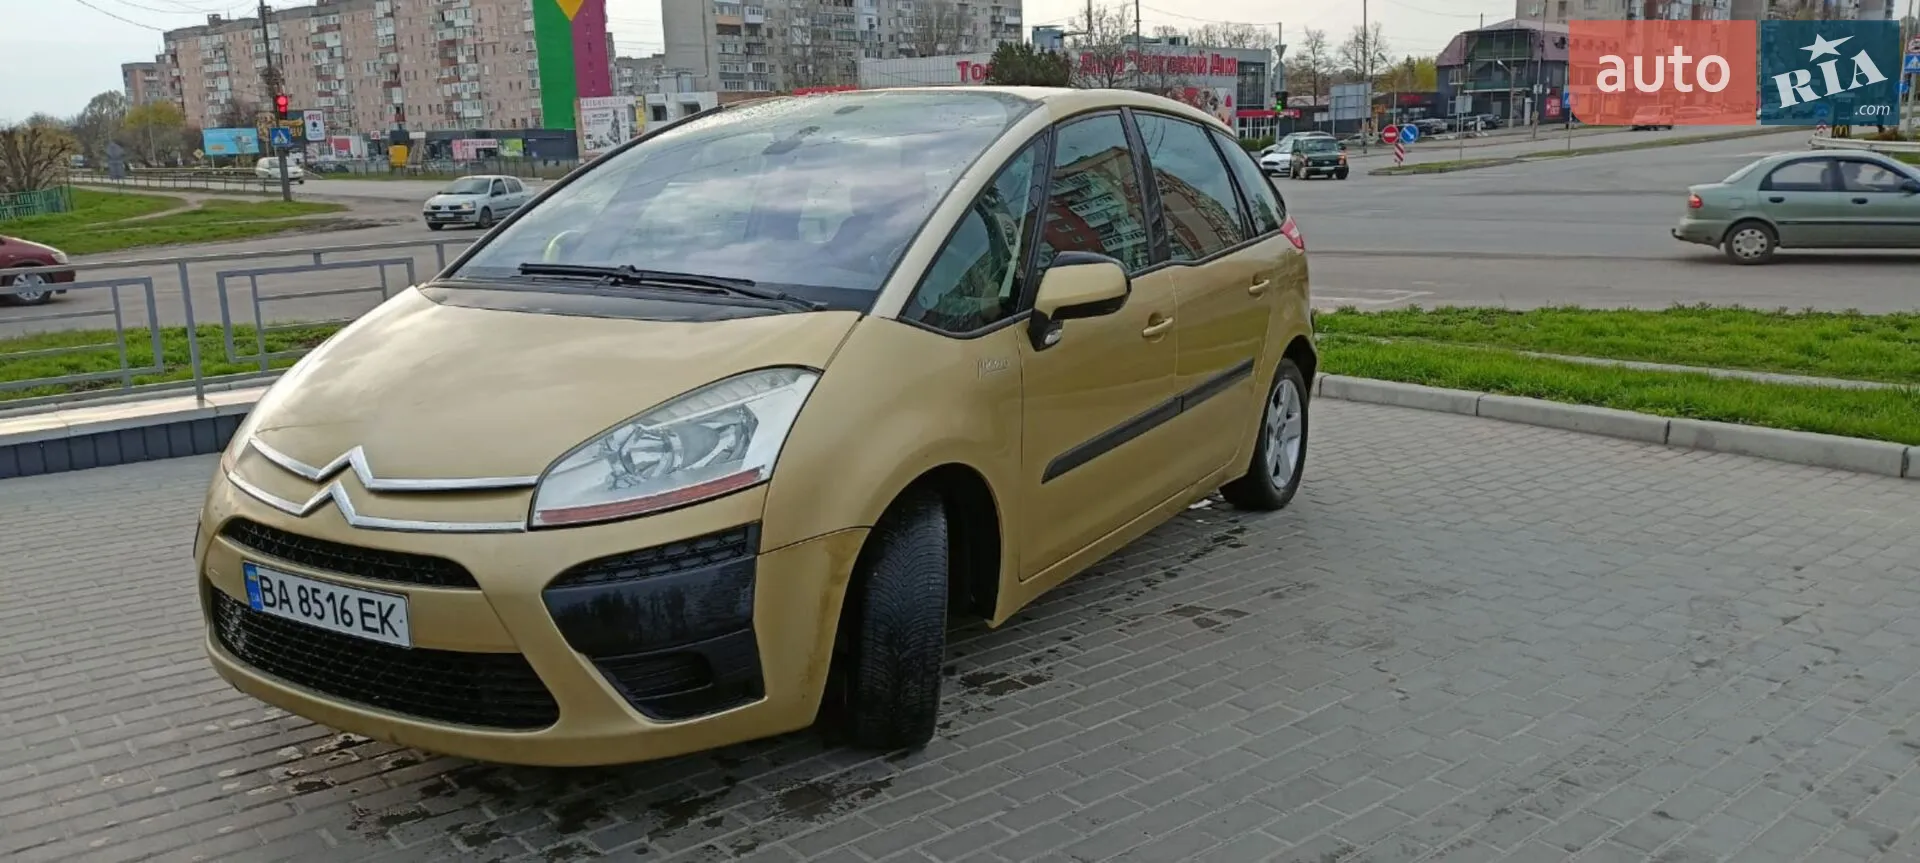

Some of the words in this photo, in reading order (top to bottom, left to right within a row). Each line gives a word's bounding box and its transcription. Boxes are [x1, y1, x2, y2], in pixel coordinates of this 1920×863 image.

[259, 575, 294, 614] BA
[297, 585, 354, 627] 8516
[358, 598, 399, 638] EK
